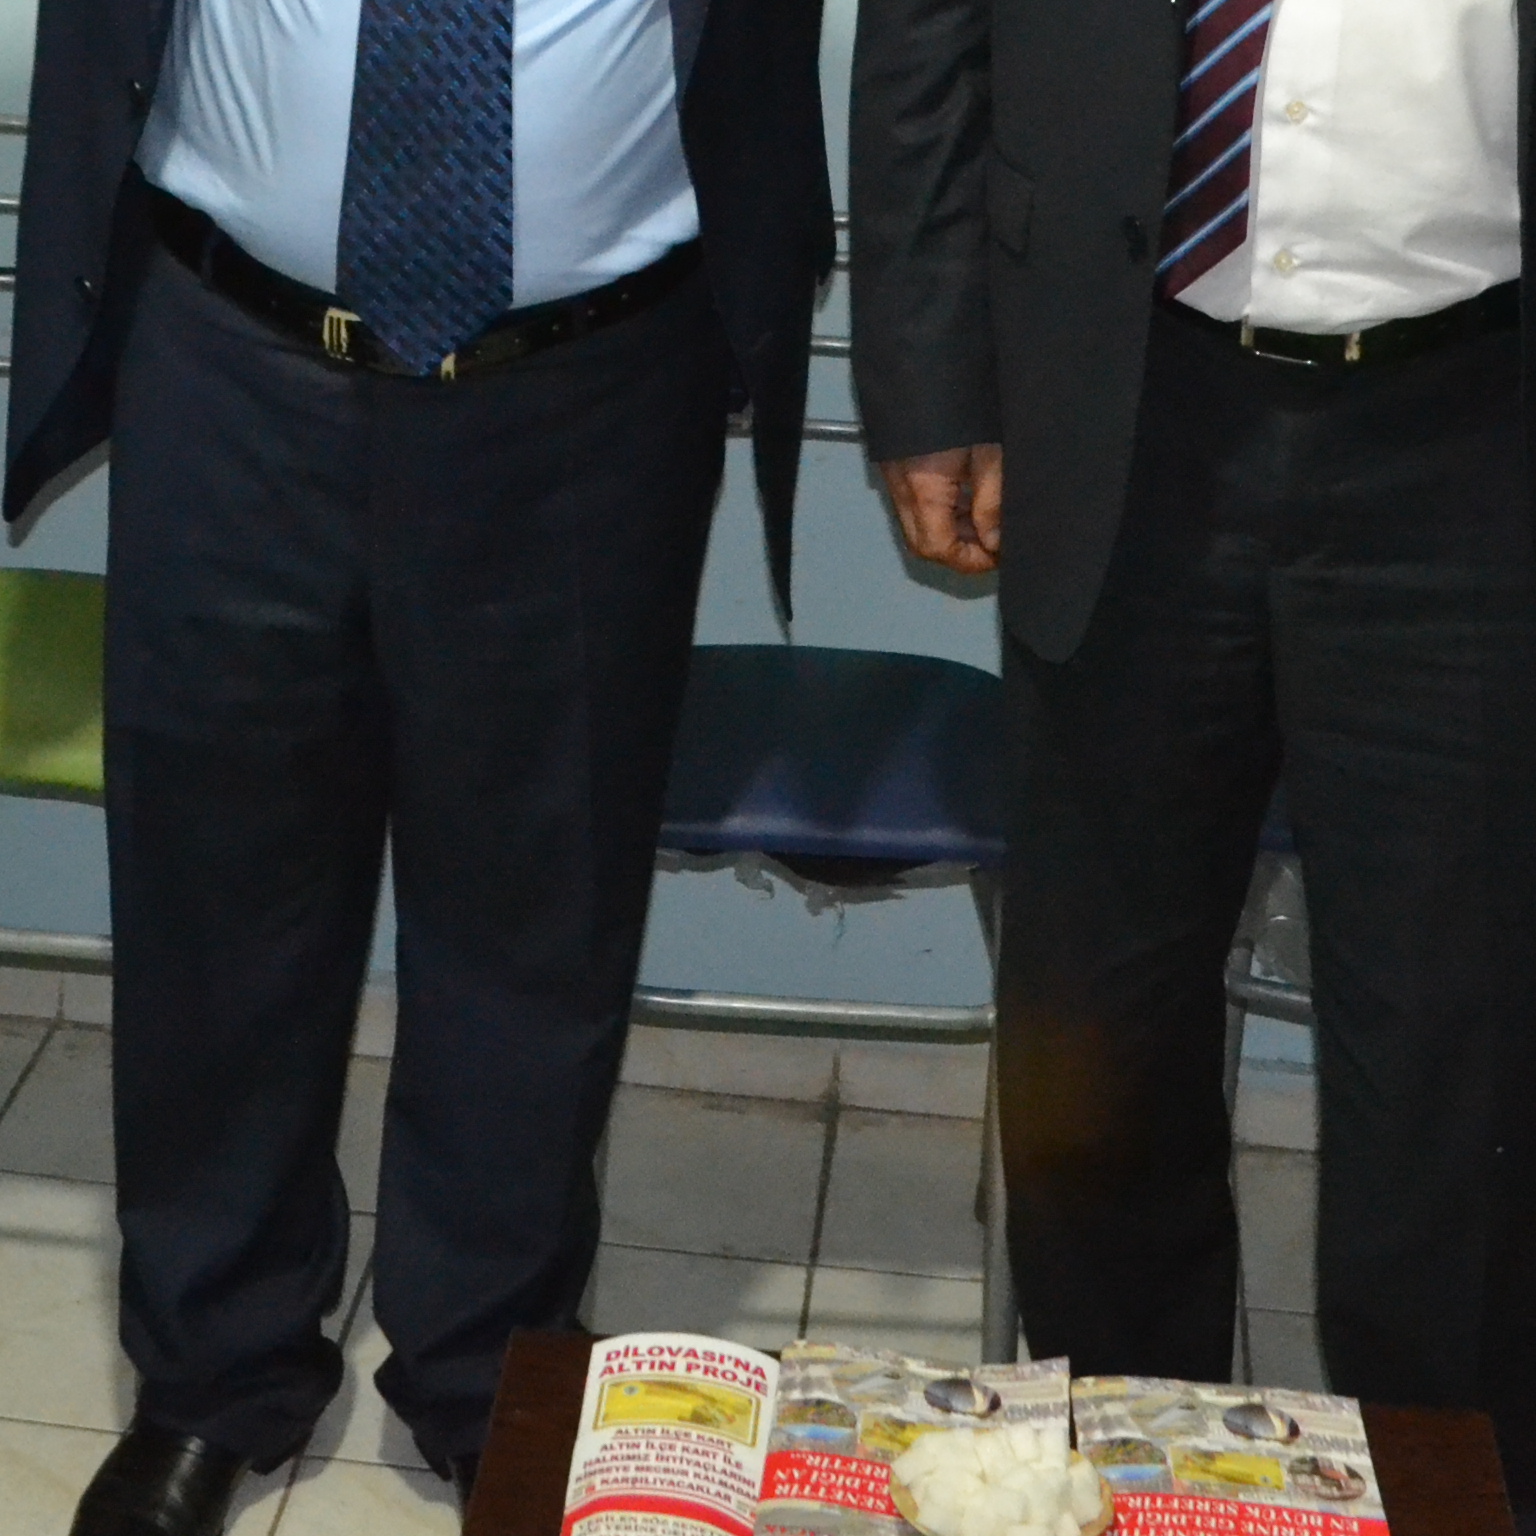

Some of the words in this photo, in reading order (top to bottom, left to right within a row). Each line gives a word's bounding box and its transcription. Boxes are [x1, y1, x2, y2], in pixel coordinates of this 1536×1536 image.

[605, 1345, 767, 1381] DİLOVASI'NA
[599, 1359, 676, 1378] ALTIN
[686, 1363, 769, 1396] PROJE
[600, 1442, 641, 1452] ALTIN
[681, 1444, 720, 1460] KART
[615, 1427, 656, 1436] ALTIN
[696, 1434, 733, 1450] KART
[810, 1469, 891, 1496] ELDİĞİ
[1330, 1519, 1360, 1534] EN
